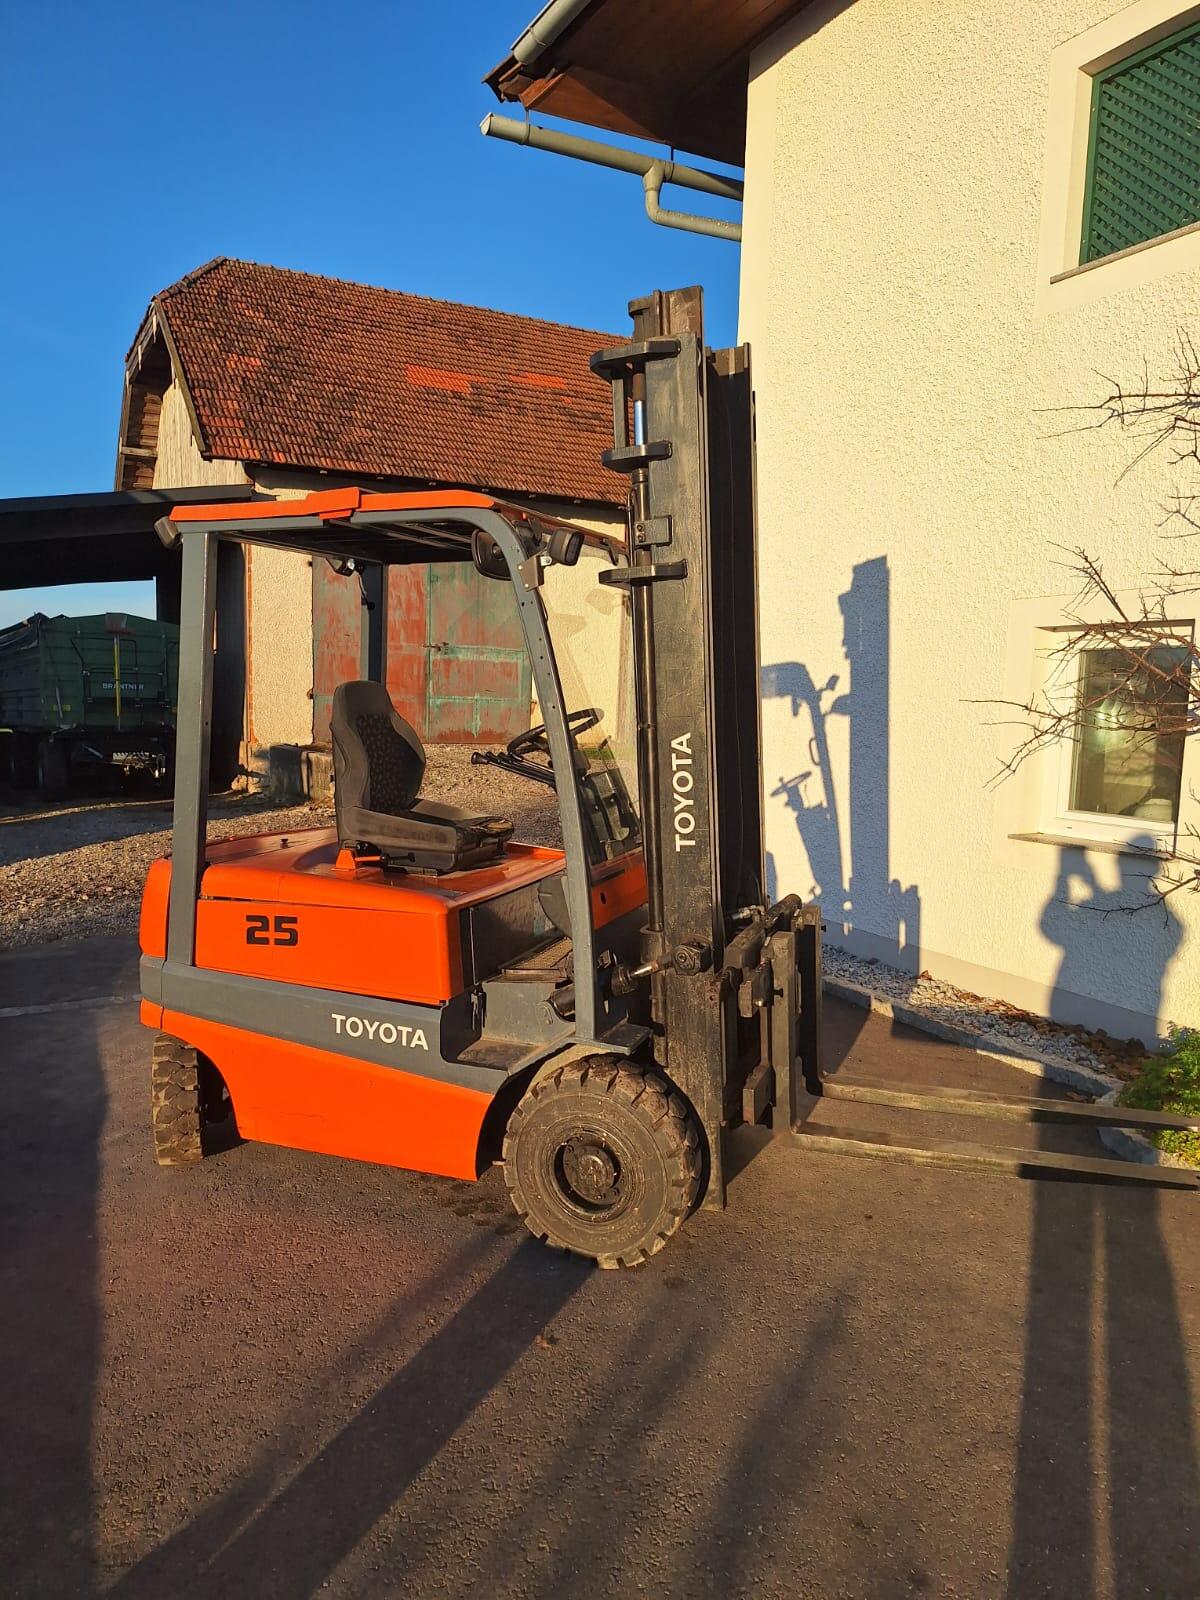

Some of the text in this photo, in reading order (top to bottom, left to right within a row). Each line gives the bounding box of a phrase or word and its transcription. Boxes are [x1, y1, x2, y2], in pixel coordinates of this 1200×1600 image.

[671, 732, 696, 852] TOYOTA
[246, 915, 299, 946] 25
[331, 1013, 429, 1050] TOYOTA
